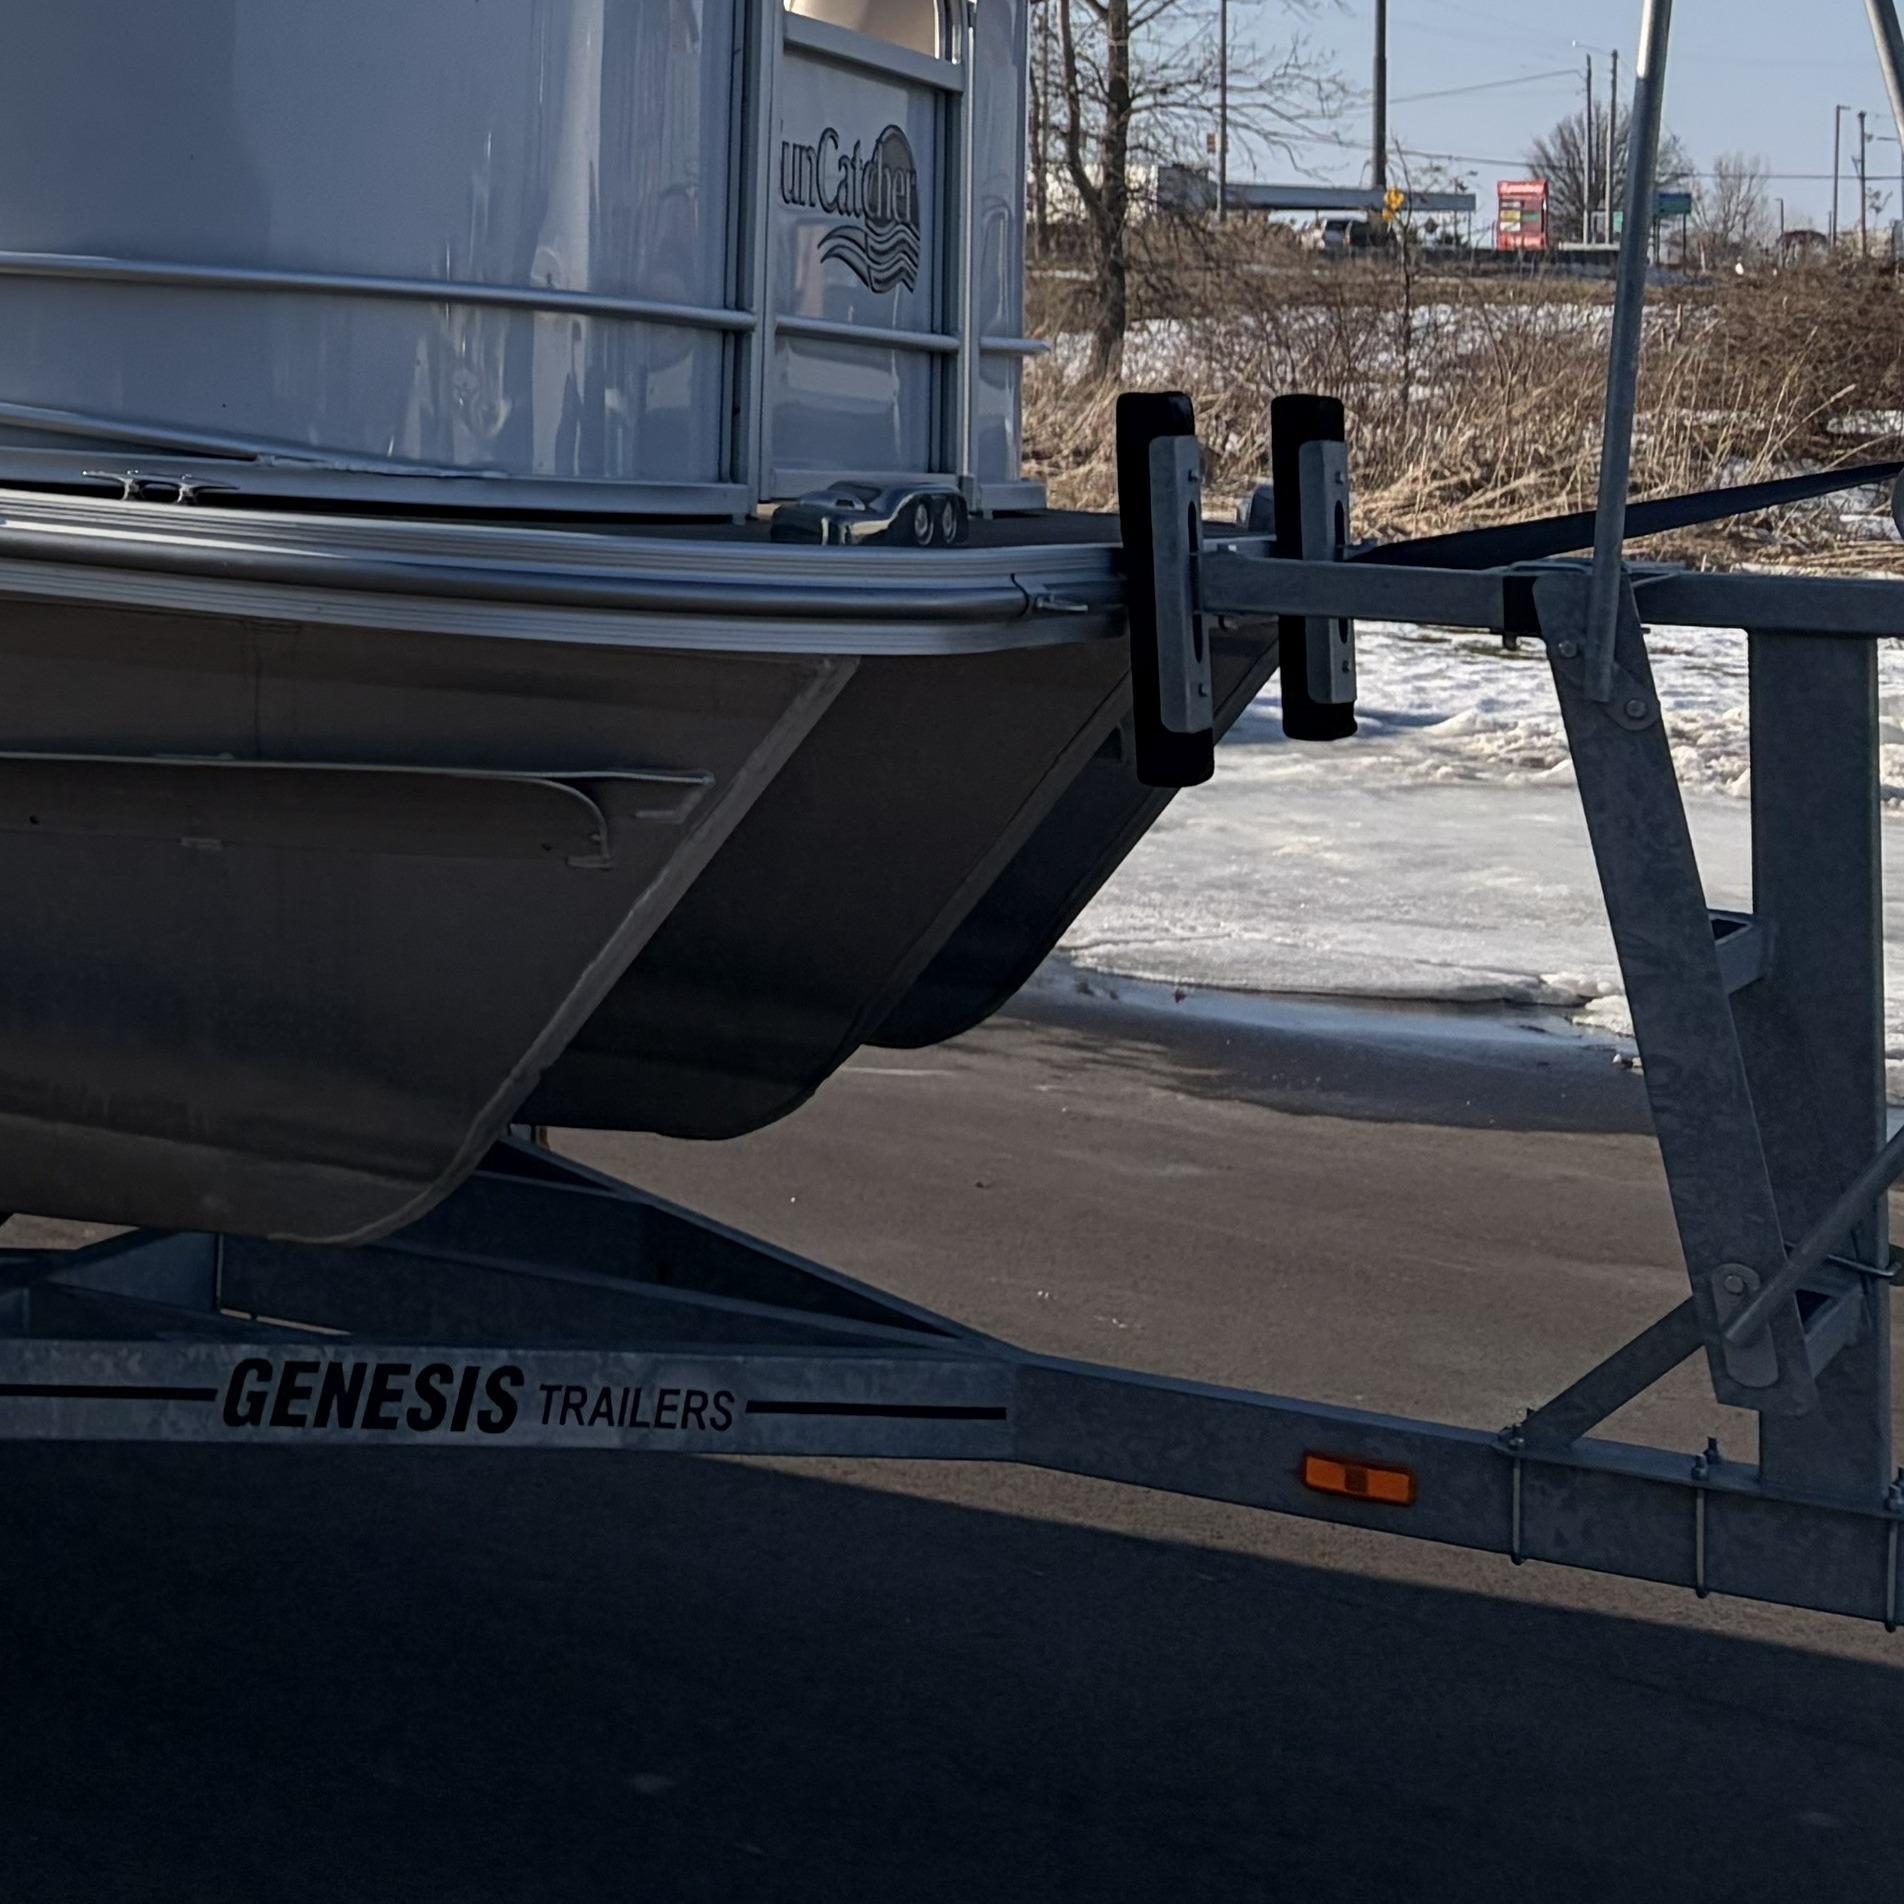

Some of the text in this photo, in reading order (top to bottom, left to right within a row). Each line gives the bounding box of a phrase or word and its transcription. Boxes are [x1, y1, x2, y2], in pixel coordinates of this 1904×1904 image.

[779, 119, 919, 225] unCatcher
[222, 1357, 736, 1435] GENESIS TRAILERS
